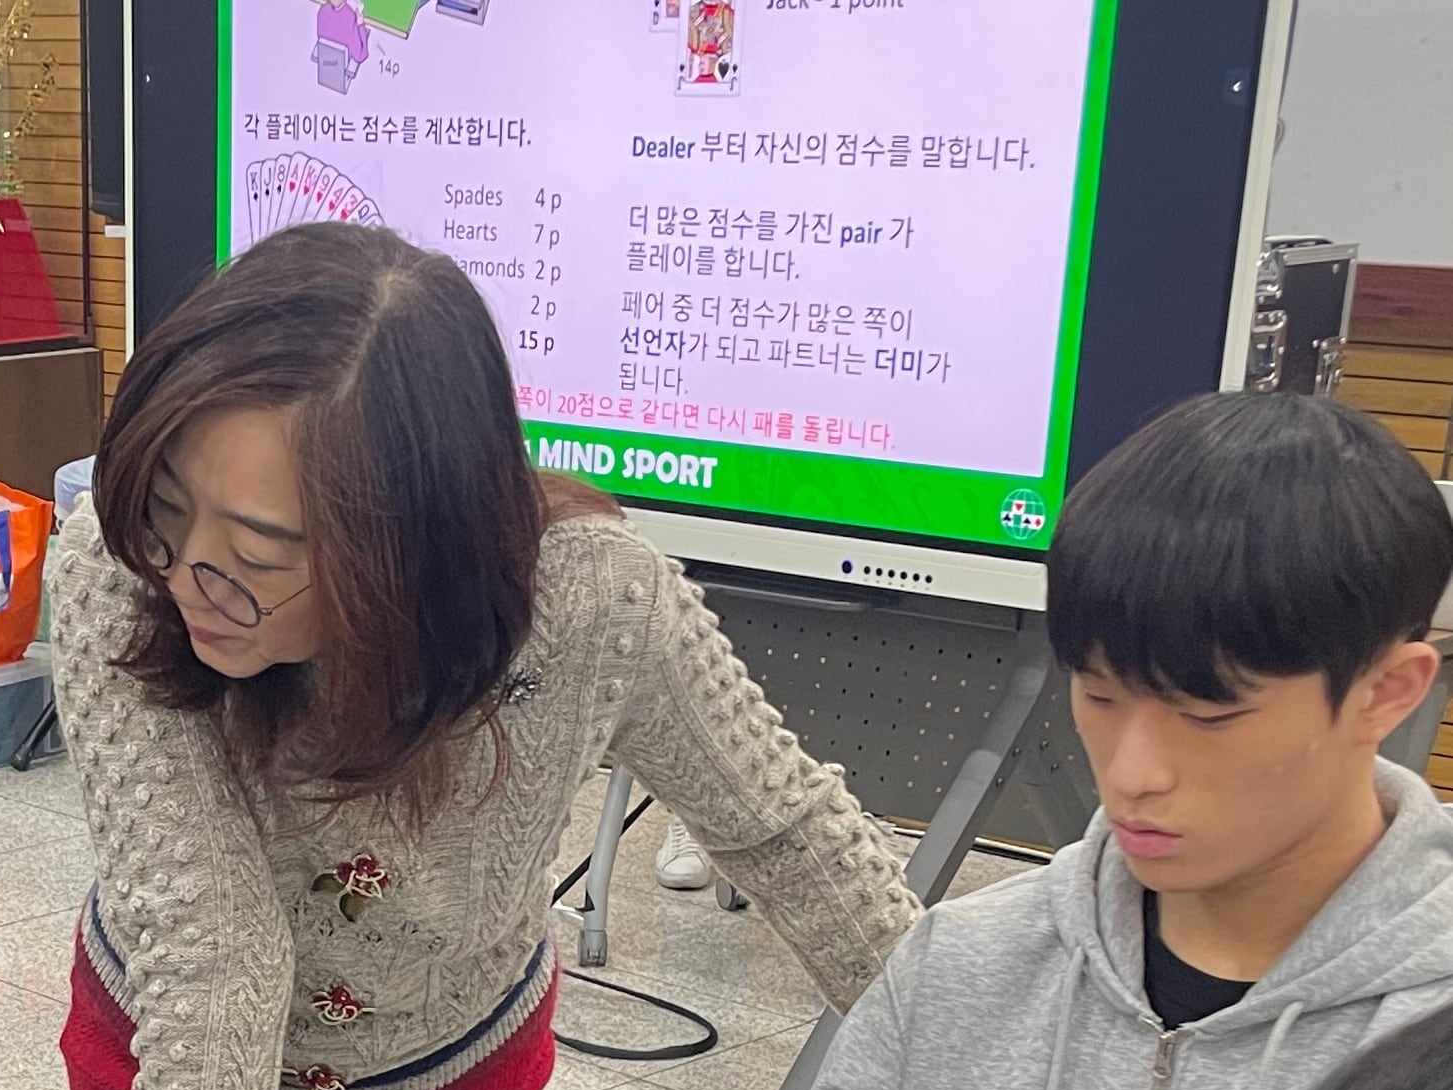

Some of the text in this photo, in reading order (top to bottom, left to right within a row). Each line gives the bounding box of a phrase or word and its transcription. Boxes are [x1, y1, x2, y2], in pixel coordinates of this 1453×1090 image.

[378, 58, 400, 77] 14p
[244, 114, 532, 147] 각 플레이어는 점수를 계산합니다.
[632, 132, 1035, 171] Dealer 부터 자신의 점수를 말합니다.
[444, 183, 562, 214] Spades 4 p
[444, 218, 560, 250] Hearts 7 p
[628, 205, 914, 249] 더 많은 점수를 가진 pair 가
[453, 255, 561, 286] iamonds 2 p
[626, 242, 800, 281] 플레이를 합니다.
[531, 295, 556, 321] 2 p
[621, 290, 914, 341] 페어 중 더 점수가 많은 쪽이
[518, 330, 555, 356] 15 p
[619, 328, 952, 384] 선언자가 되고 파트너는 더미가
[618, 361, 689, 396] 됩니다.
[557, 392, 635, 420] 20점으로
[640, 398, 700, 430] 같다면
[707, 404, 746, 434] 다시
[752, 409, 795, 441] 패를
[801, 414, 896, 450] 돌립니다.
[538, 437, 718, 489] MIND SPORT
